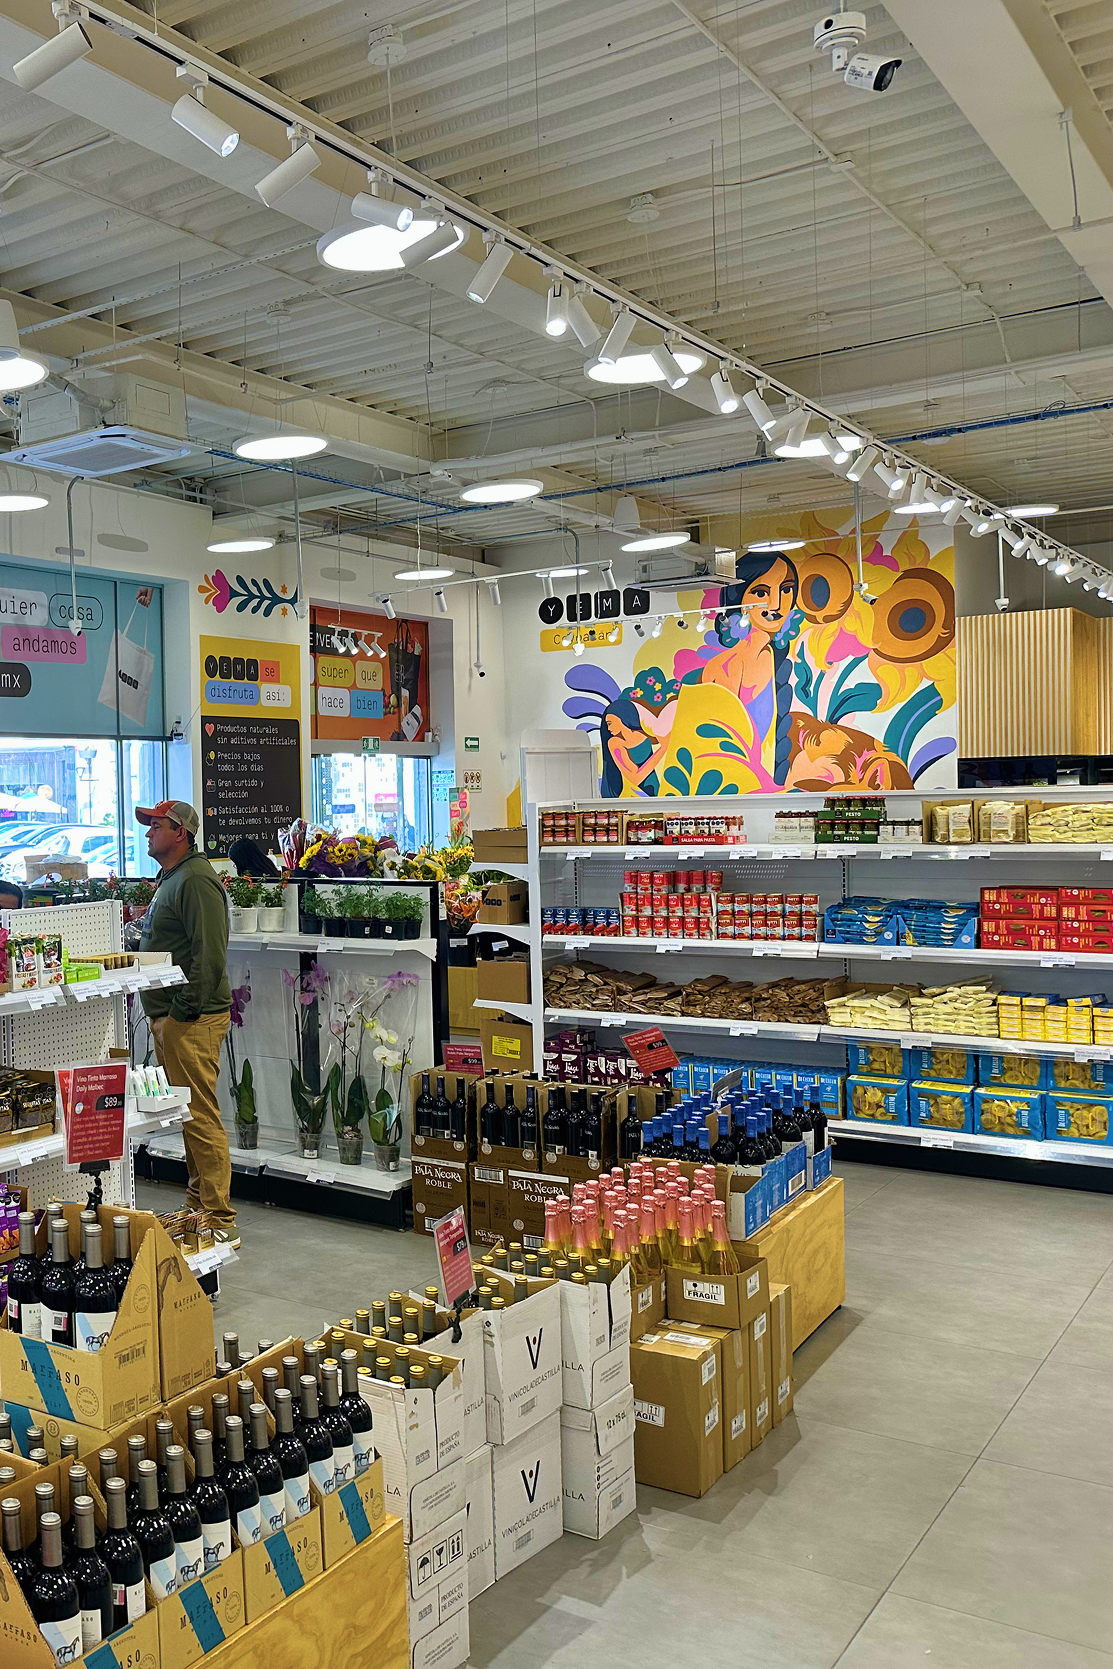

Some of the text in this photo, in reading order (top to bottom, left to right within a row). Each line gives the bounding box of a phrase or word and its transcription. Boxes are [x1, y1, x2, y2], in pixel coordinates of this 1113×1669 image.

[58, 604, 94, 621] cosa
[547, 595, 642, 617] YEMA
[12, 635, 78, 655] andamos
[209, 662, 275, 678] YEMA se
[321, 664, 377, 682] súper que
[210, 684, 286, 702] disfruta así:
[321, 694, 378, 711] hace bien
[216, 723, 279, 735] Productos naturales
[217, 735, 297, 747] sin aditivos artificiales
[217, 751, 261, 762] Precios bajos
[217, 762, 235, 771] todos
[237, 762, 248, 771] los
[217, 778, 232, 787] Gran
[234, 778, 257, 788] surtido
[218, 788, 249, 799] selección
[218, 804, 259, 815] Satisfacción
[261, 804, 268, 813] al
[270, 804, 283, 813] 100%
[218, 815, 293, 826] te devolvemos tu dinero
[219, 832, 242, 844] Mejores
[245, 833, 259, 843] para
[261, 831, 268, 841] ti
[219, 845, 226, 854] el
[76, 1073, 99, 1083] Vino Tinto
[76, 1083, 104, 1094] Daily Malbec
[415, 1164, 463, 1183] PATA NEGRA
[425, 1178, 453, 1190] ROBLE
[511, 1179, 565, 1196] PATA NEGRA
[687, 1290, 719, 1301] FRAGIL
[615, 1413, 622, 1425] 75
[439, 1430, 461, 1449] PRODUCTO
[439, 1439, 461, 1459] DE ESPAÑA
[501, 1494, 561, 1539] VINICOLADECASTILLA
[441, 1581, 464, 1603] PRODUCTO
[441, 1590, 464, 1613] DE ESPAÑA
